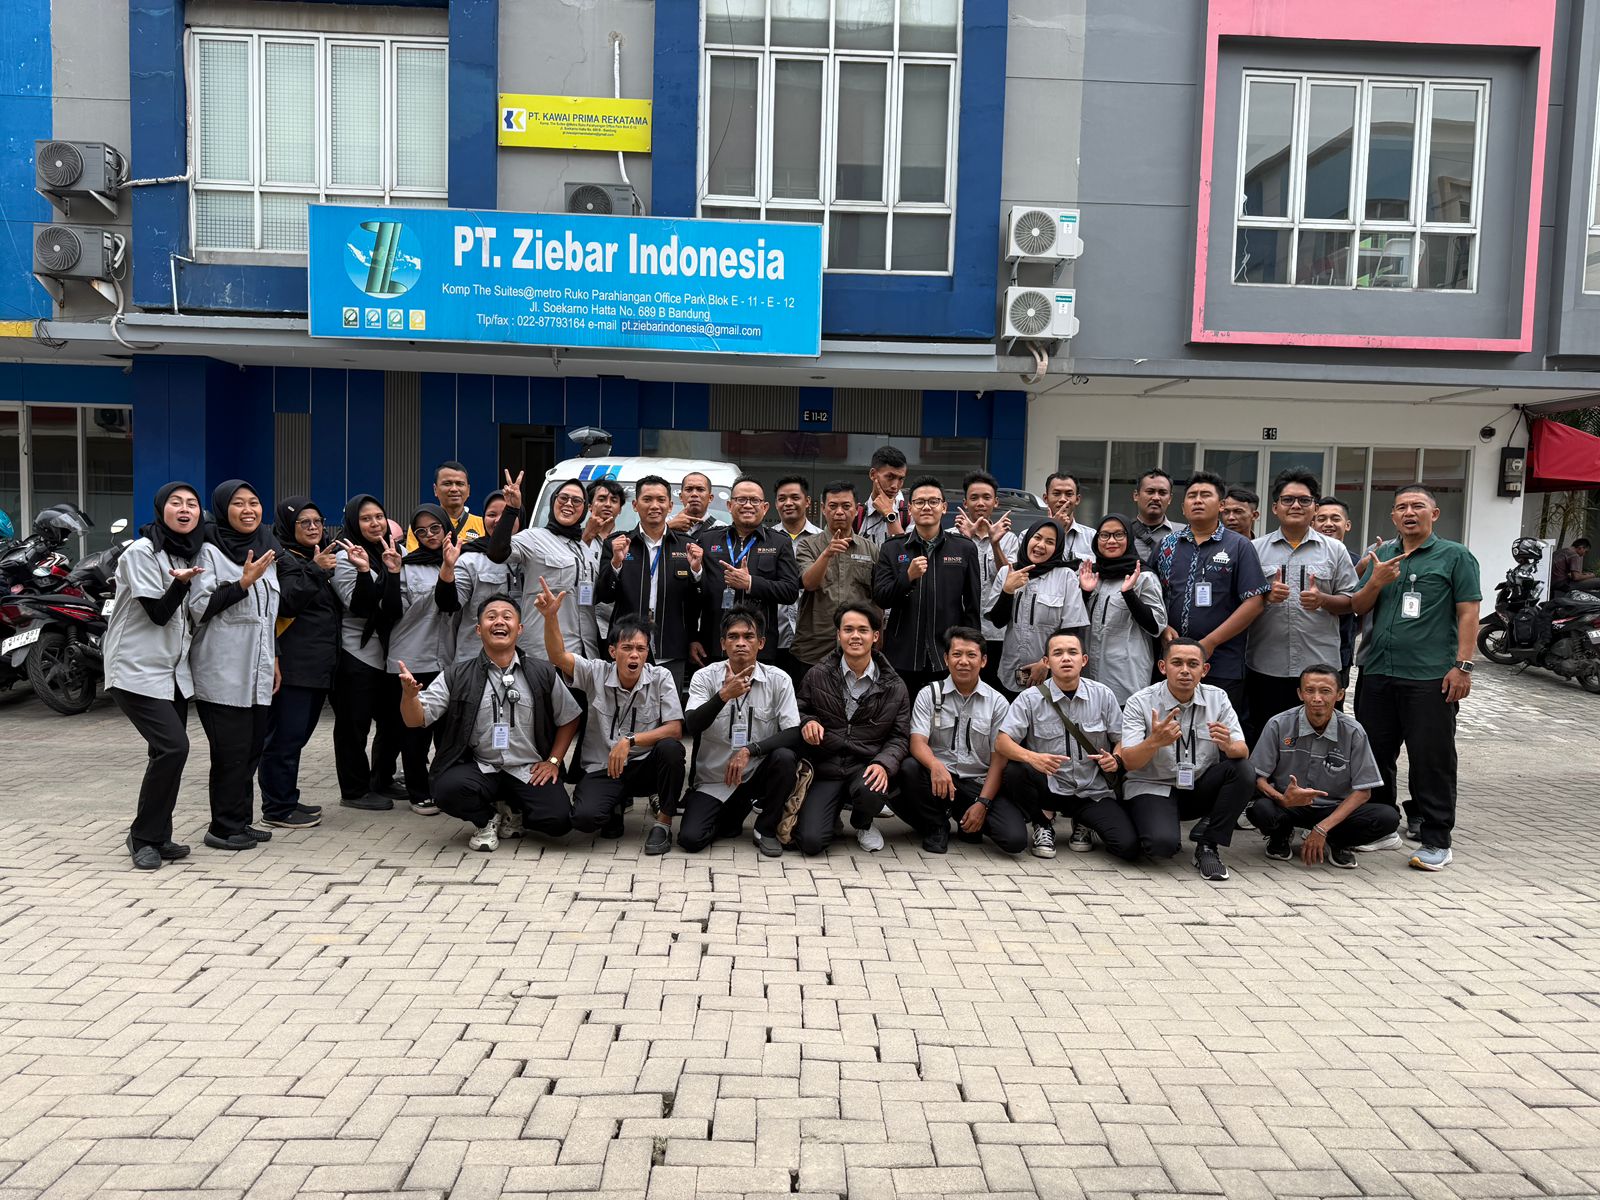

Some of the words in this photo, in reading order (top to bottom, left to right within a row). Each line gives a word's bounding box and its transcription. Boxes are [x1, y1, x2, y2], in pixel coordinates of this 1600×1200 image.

[528, 111, 540, 121] PT.
[543, 112, 570, 122] KAWAI
[573, 113, 600, 123] PRIMA
[602, 115, 649, 126] REKATAMA
[454, 225, 501, 268] PT.
[512, 228, 619, 273] Ziebar
[629, 233, 785, 280] Indonesia
[442, 283, 471, 297] Komp
[473, 284, 492, 296] The
[494, 285, 562, 300] Suites@metro
[564, 287, 589, 300] Ruko
[591, 289, 652, 305] Parahiangan
[654, 292, 682, 304] Office
[684, 293, 706, 305] Park
[708, 294, 729, 306] Blok
[731, 295, 739, 306] E
[748, 296, 758, 307] 11
[767, 297, 774, 308] E
[784, 297, 795, 308] 12
[530, 301, 540, 313] Jl.
[543, 302, 588, 315] Soekarno
[591, 304, 617, 316] Hatta
[619, 305, 636, 317] No.
[638, 307, 656, 318] 689
[659, 308, 666, 318] B
[668, 308, 710, 322] Bandung
[476, 313, 509, 327] Tlp/fax
[517, 315, 586, 329] 022-87793164
[588, 318, 617, 331] e-mail
[621, 320, 761, 337] pt.ziebarindonesia@gmail.com
[804, 411, 810, 421] E
[812, 412, 828, 421] 11-12
